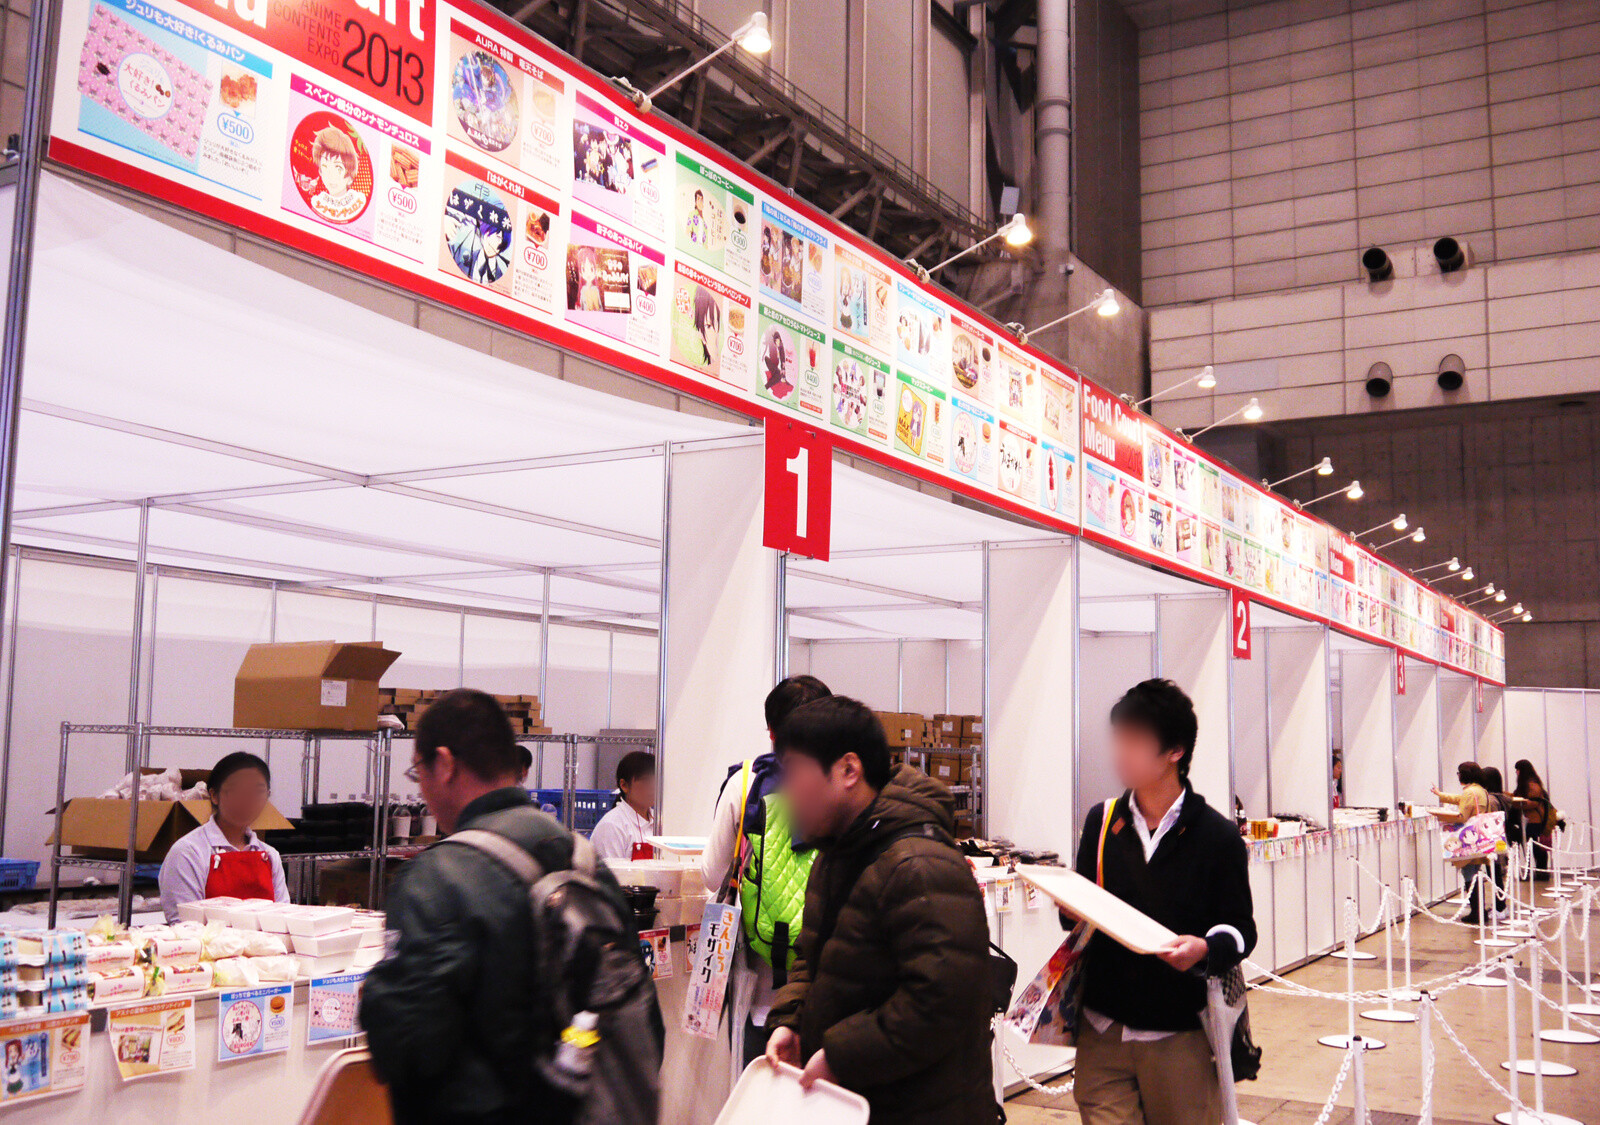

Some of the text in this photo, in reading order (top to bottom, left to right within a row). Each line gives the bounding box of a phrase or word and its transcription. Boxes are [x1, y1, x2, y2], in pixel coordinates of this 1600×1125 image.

[272, 1, 342, 48] CONTENTS
[302, 0, 342, 28] ANIME
[307, 37, 340, 66] EXPO
[342, 19, 424, 106] 2013
[475, 33, 499, 54] AURA
[222, 117, 250, 140] ¥500
[304, 82, 420, 148] スペイン親分のシナモンチュロス
[391, 191, 414, 210] ¥500
[527, 250, 545, 267] ¥700
[1084, 383, 1112, 426] Food
[1085, 417, 1115, 462] Menu
[786, 446, 808, 538] 1
[1236, 600, 1248, 650] 2
[701, 922, 721, 984] モザイク
[716, 911, 733, 973] きんいろ
